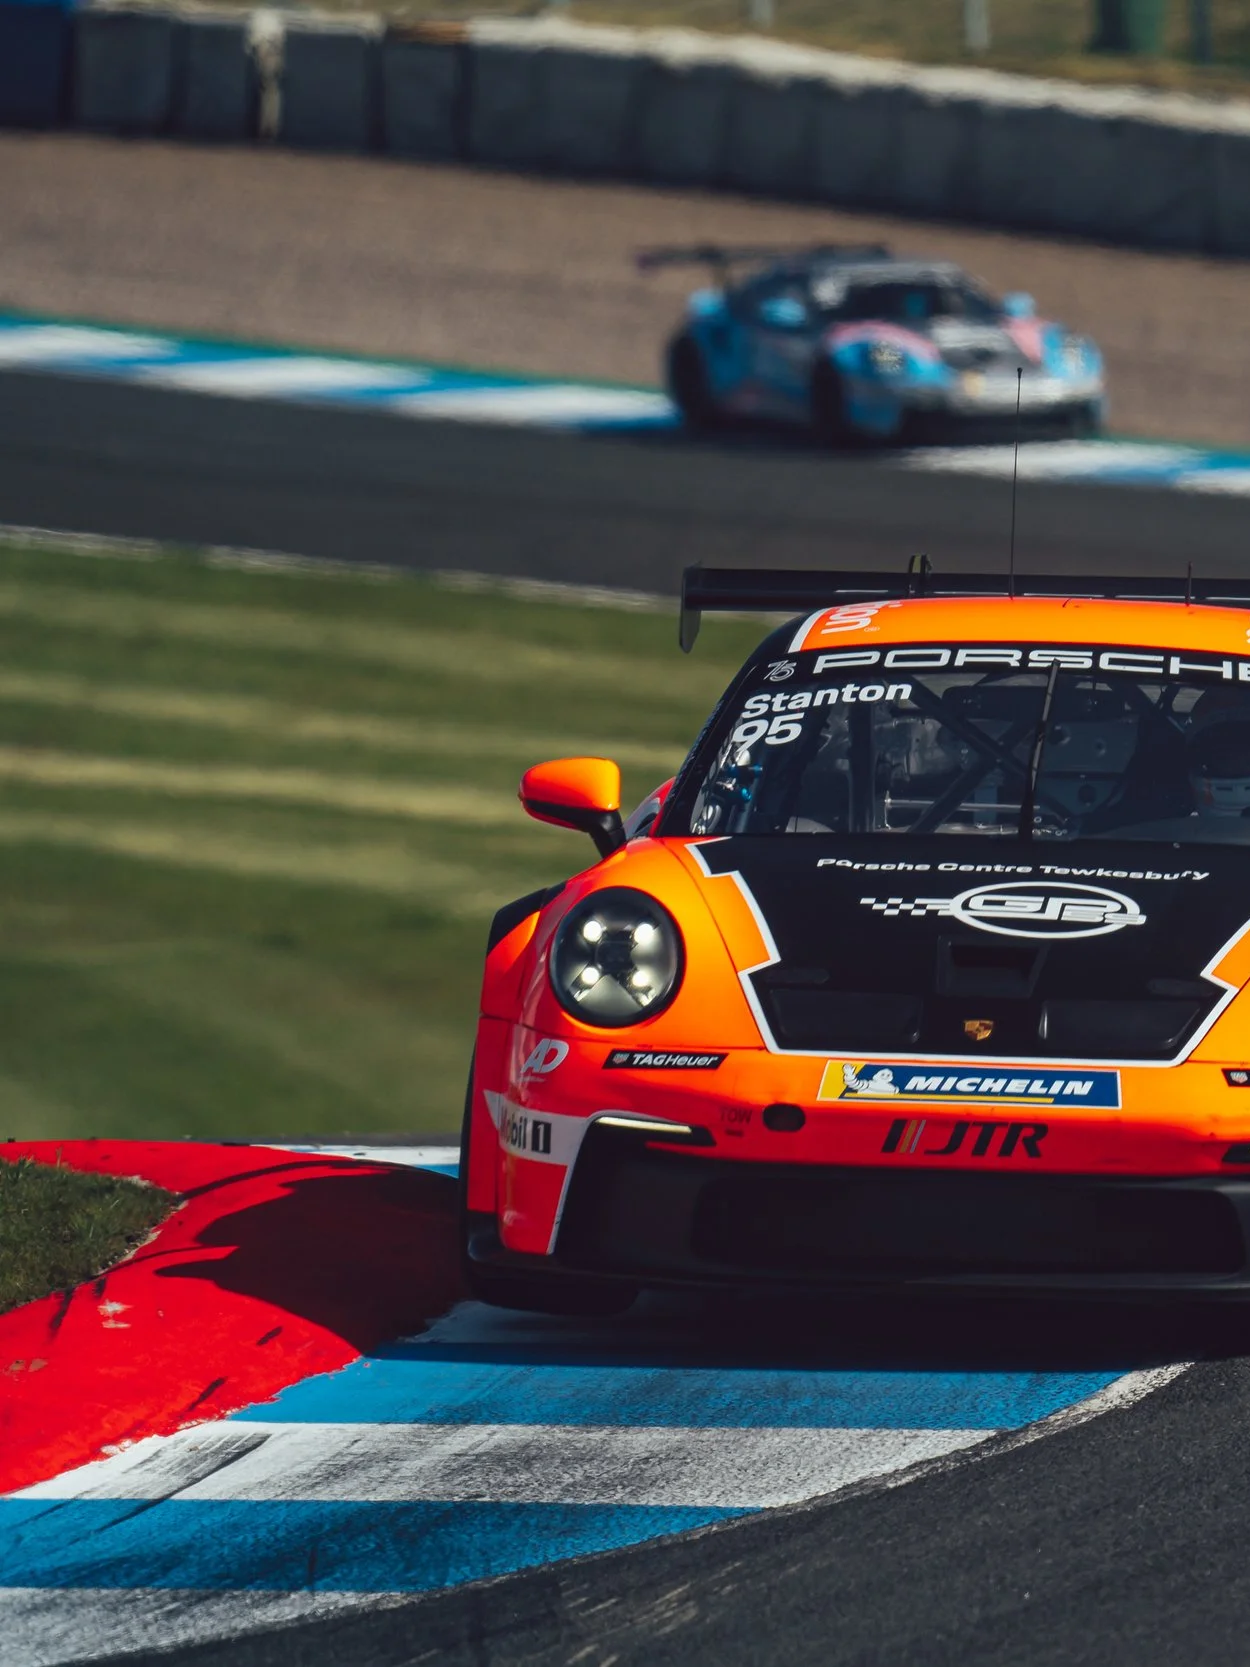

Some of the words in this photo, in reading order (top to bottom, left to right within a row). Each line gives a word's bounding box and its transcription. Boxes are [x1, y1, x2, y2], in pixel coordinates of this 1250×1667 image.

[740, 683, 912, 720] Stanton
[731, 712, 804, 752] 95
[816, 858, 931, 871] Porsche
[937, 862, 1033, 873] Centre
[1039, 865, 1210, 880] Tewkesbury
[904, 1074, 1094, 1096] MICHELIN
[923, 1120, 1049, 1158] JTR
